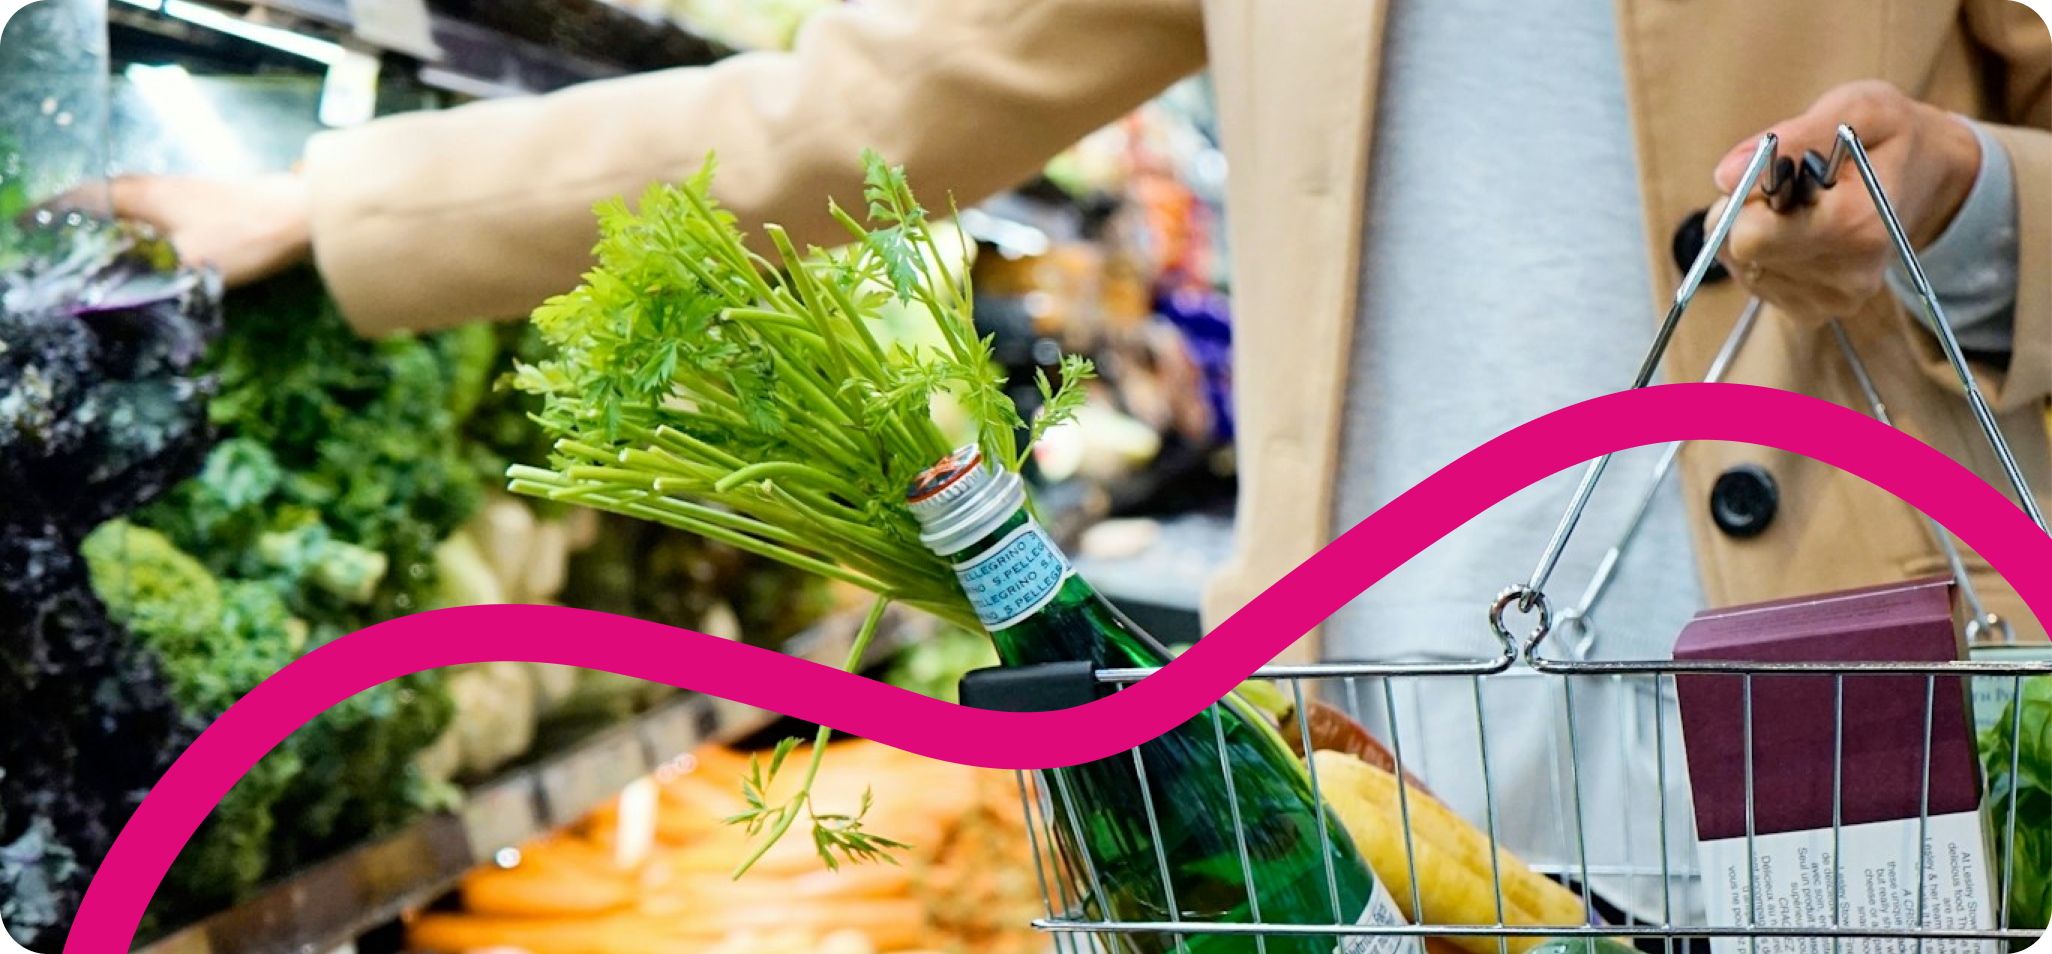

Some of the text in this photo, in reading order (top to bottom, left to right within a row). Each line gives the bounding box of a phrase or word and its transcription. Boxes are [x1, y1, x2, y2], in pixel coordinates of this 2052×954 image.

[1797, 847, 1810, 871] Seul
[1948, 842, 1961, 887] delicious
[1962, 852, 1971, 862] At
[1728, 865, 1738, 890] vous
[1761, 855, 1774, 901] Délicieux
[1800, 873, 1810, 886] un
[1811, 862, 1822, 886] avec
[1929, 873, 1938, 881] &
[1963, 865, 1974, 899] Lesley
[1731, 891, 1741, 906] ne
[1864, 868, 1876, 906] cheese
[1930, 883, 1939, 900] her
[1803, 888, 1816, 923] produit
[1880, 886, 1890, 914] really
[1932, 904, 1942, 929] team
